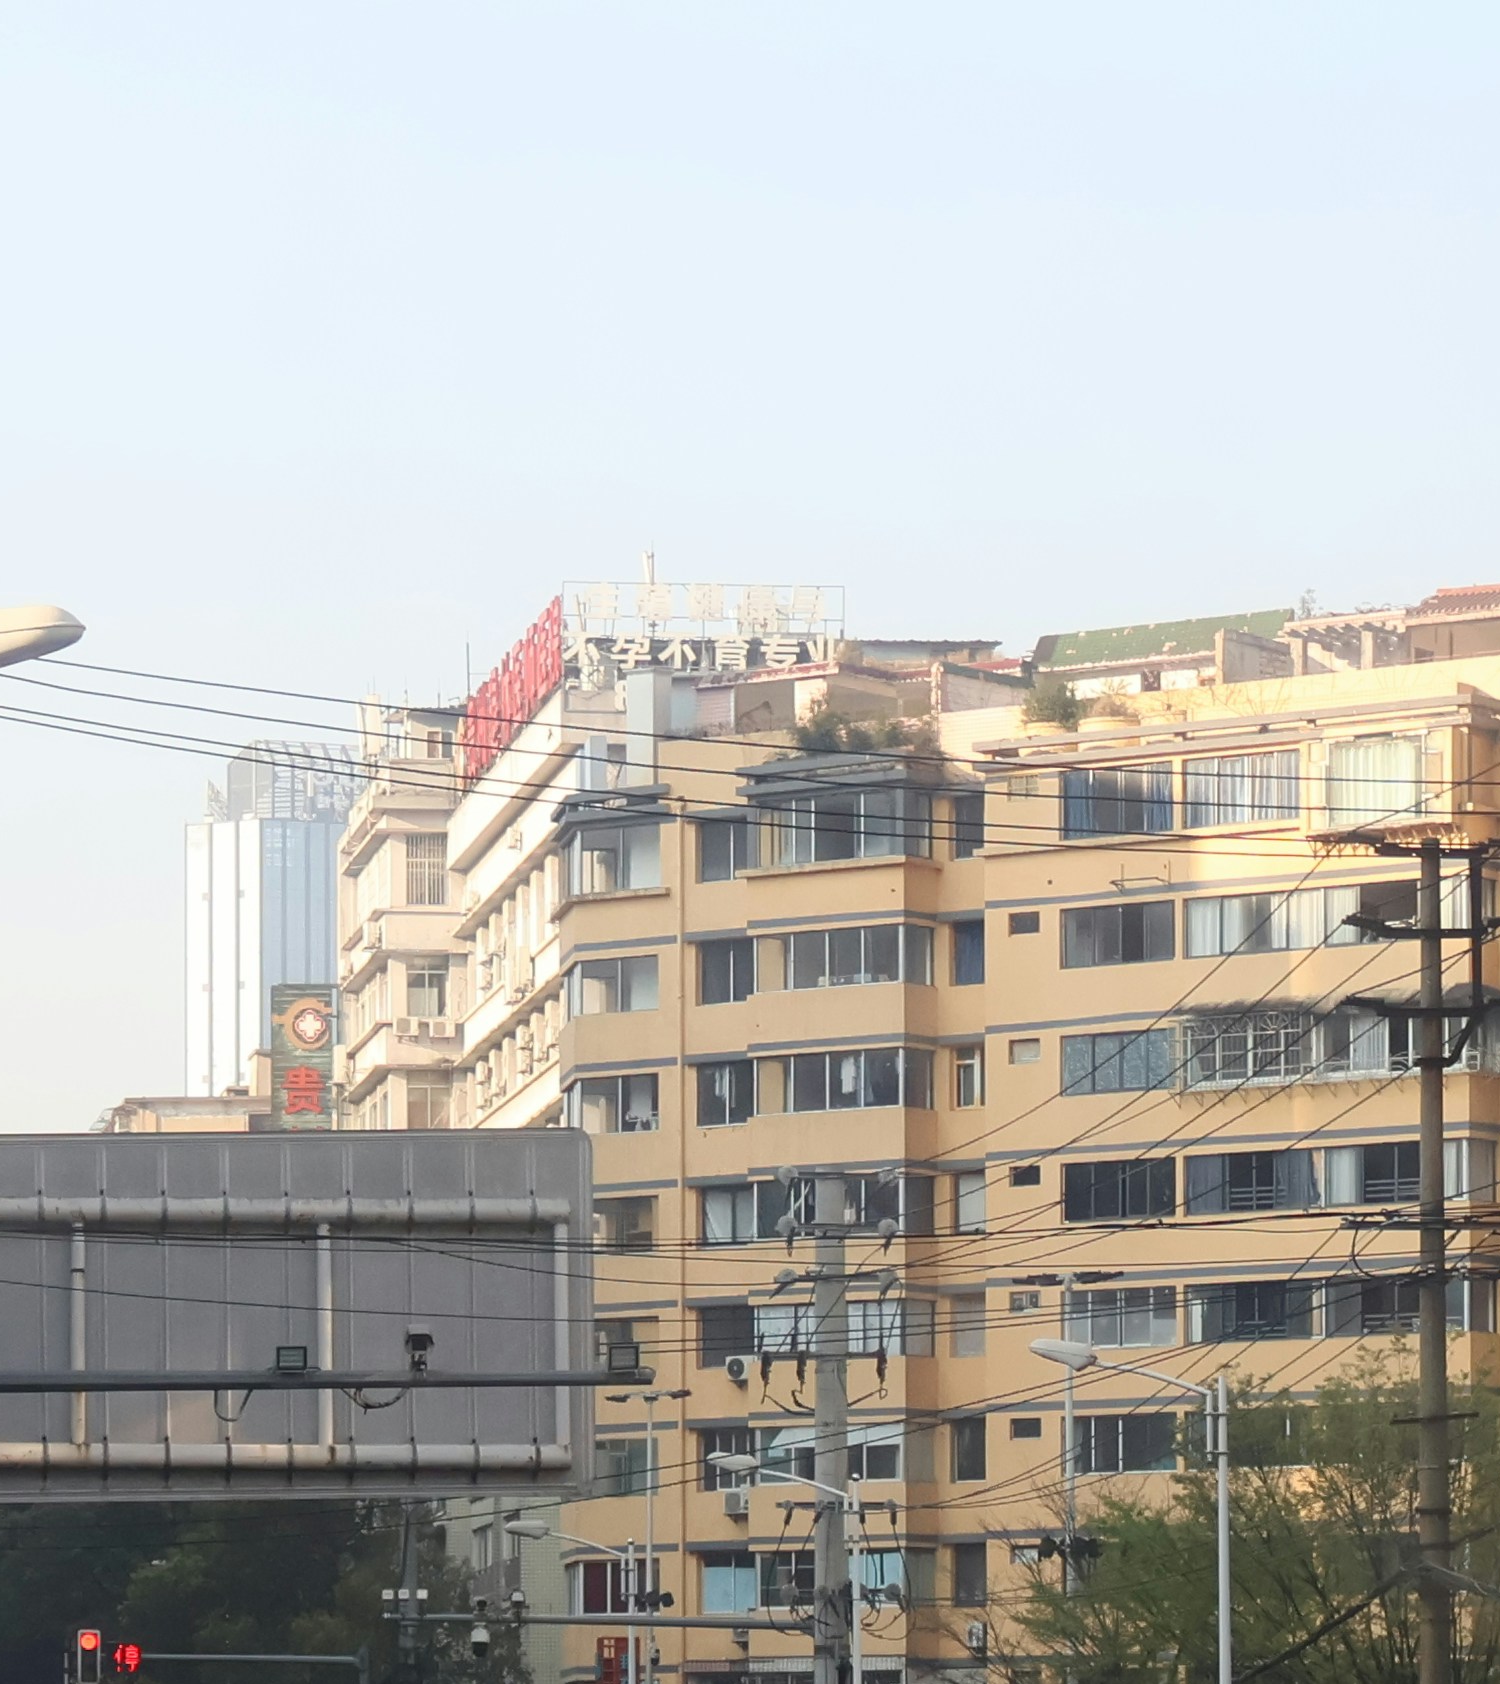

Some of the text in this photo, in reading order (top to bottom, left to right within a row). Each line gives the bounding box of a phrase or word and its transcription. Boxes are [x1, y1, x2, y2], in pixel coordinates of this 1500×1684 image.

[563, 634, 835, 670] 不孕不育专业
[281, 1066, 326, 1115] 贵
[114, 1644, 141, 1672] 停
